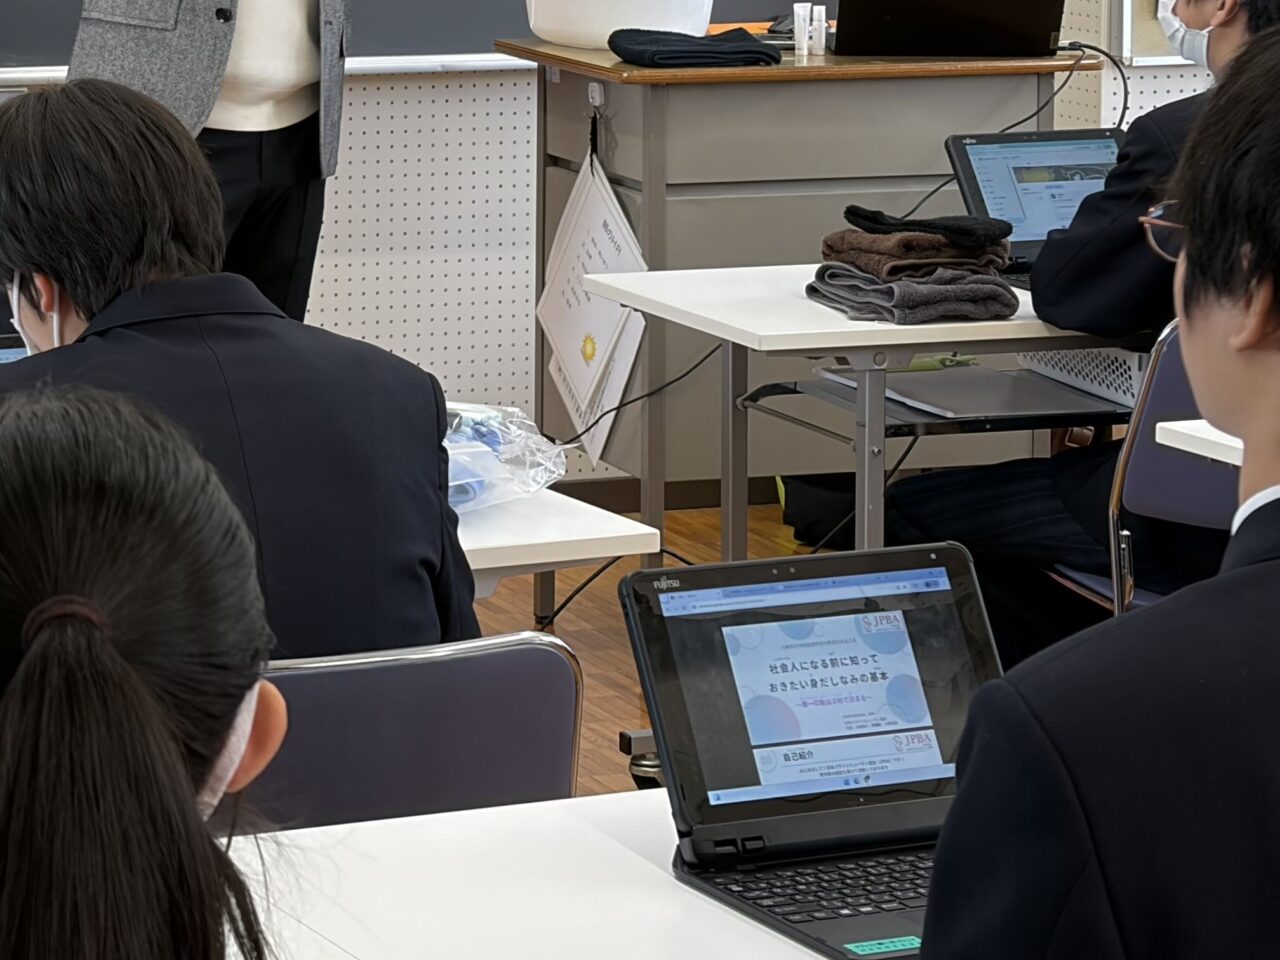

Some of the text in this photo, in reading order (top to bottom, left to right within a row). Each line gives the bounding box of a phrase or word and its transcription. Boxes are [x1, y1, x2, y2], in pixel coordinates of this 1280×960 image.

[653, 576, 680, 590] FUJITSU
[873, 614, 901, 628] JPBA
[769, 654, 879, 675] 社会人になる前に知って
